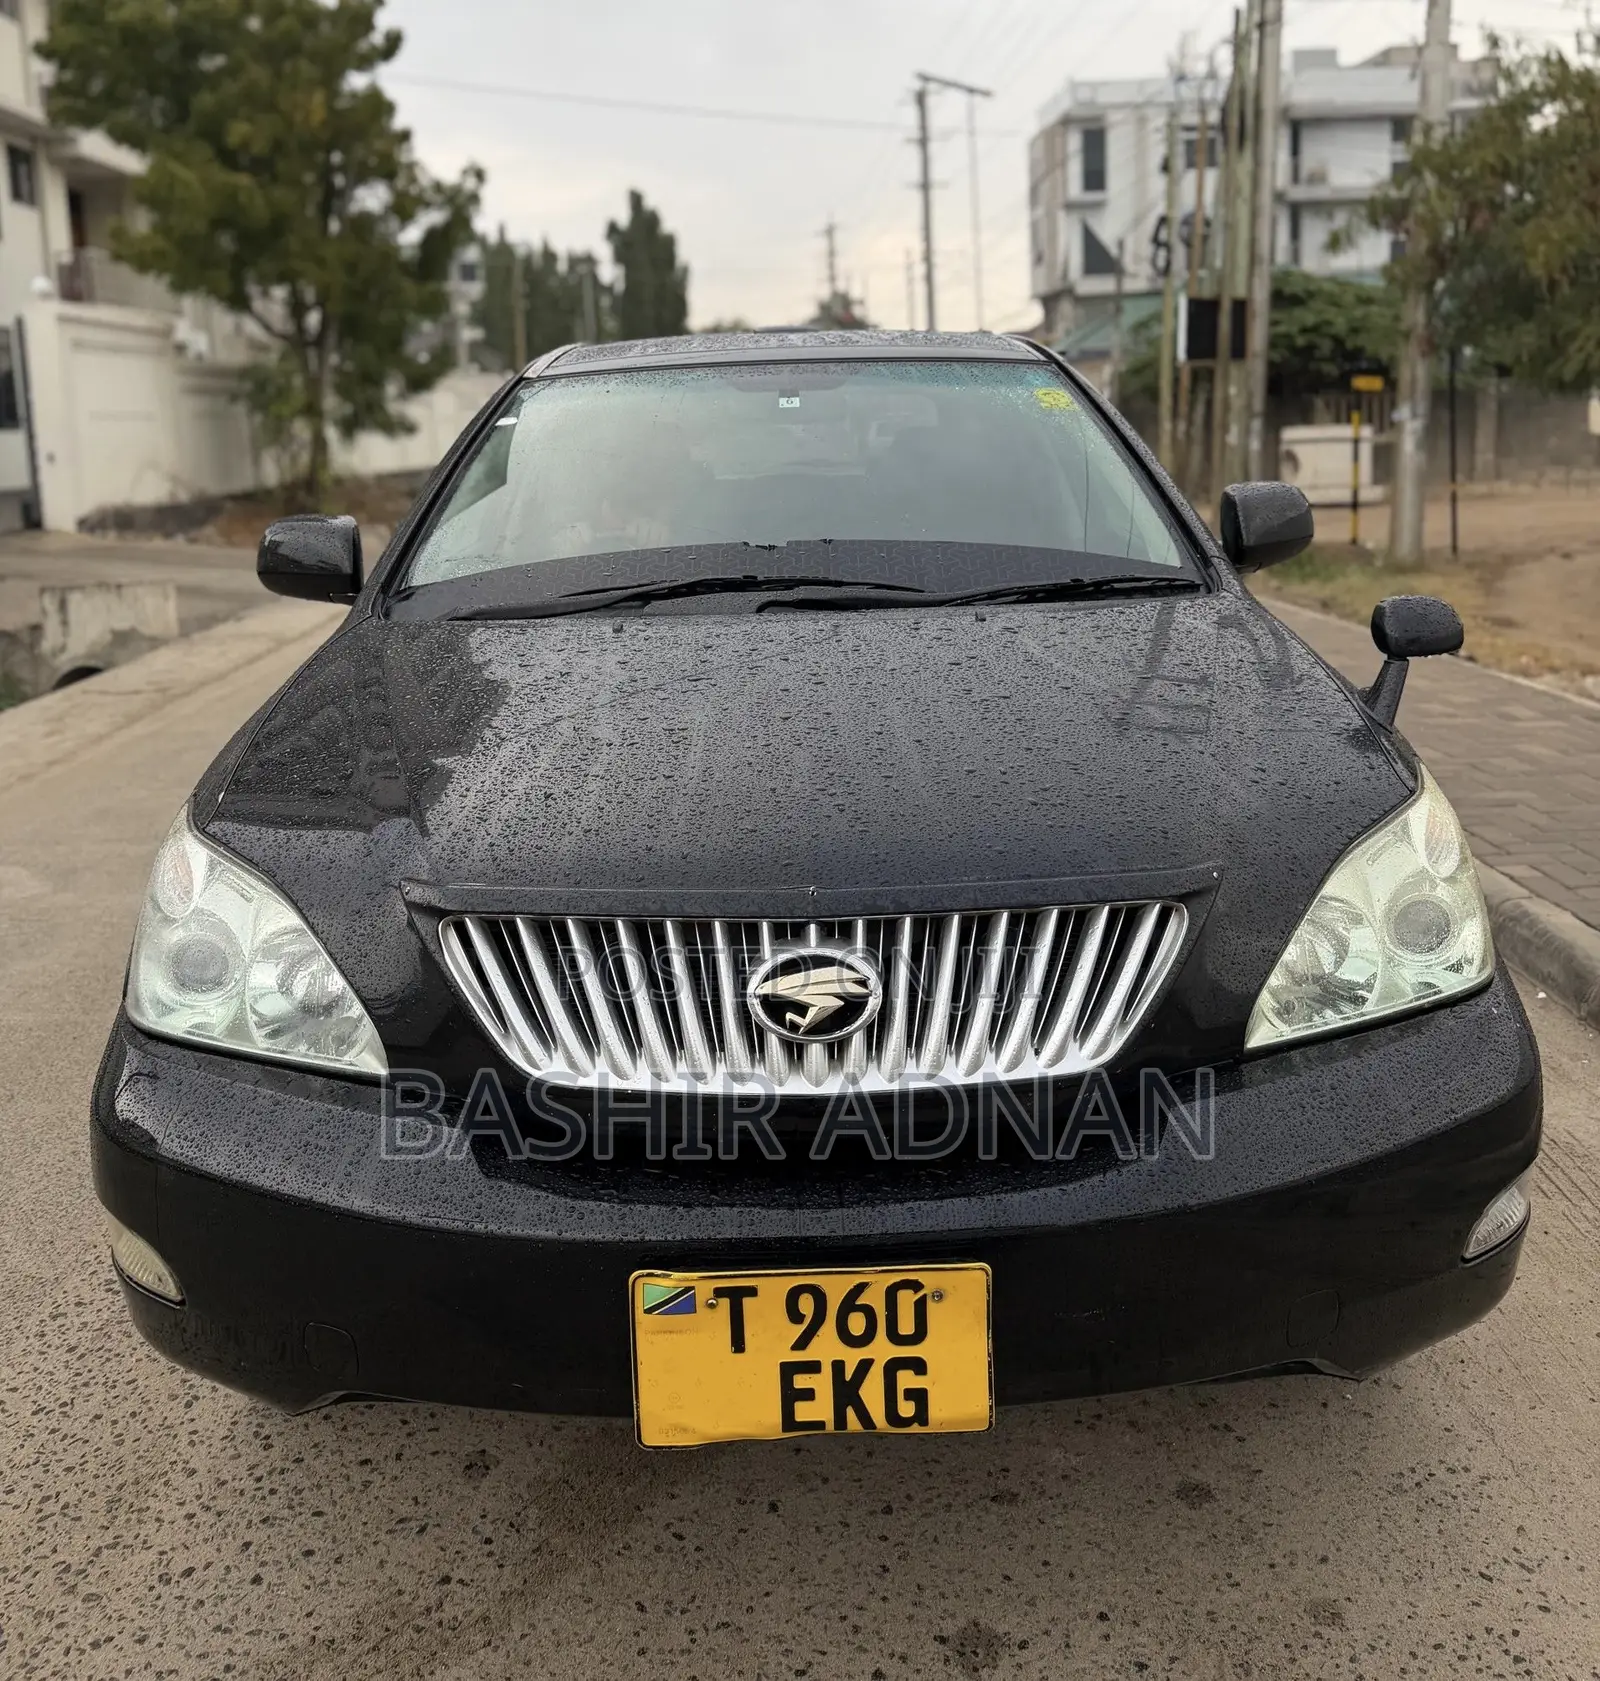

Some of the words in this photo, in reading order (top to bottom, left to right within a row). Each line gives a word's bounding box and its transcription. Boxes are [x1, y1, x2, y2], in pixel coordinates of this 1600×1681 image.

[713, 1285, 759, 1354] T
[785, 1278, 928, 1351] 960
[779, 1356, 929, 1433] EKG
